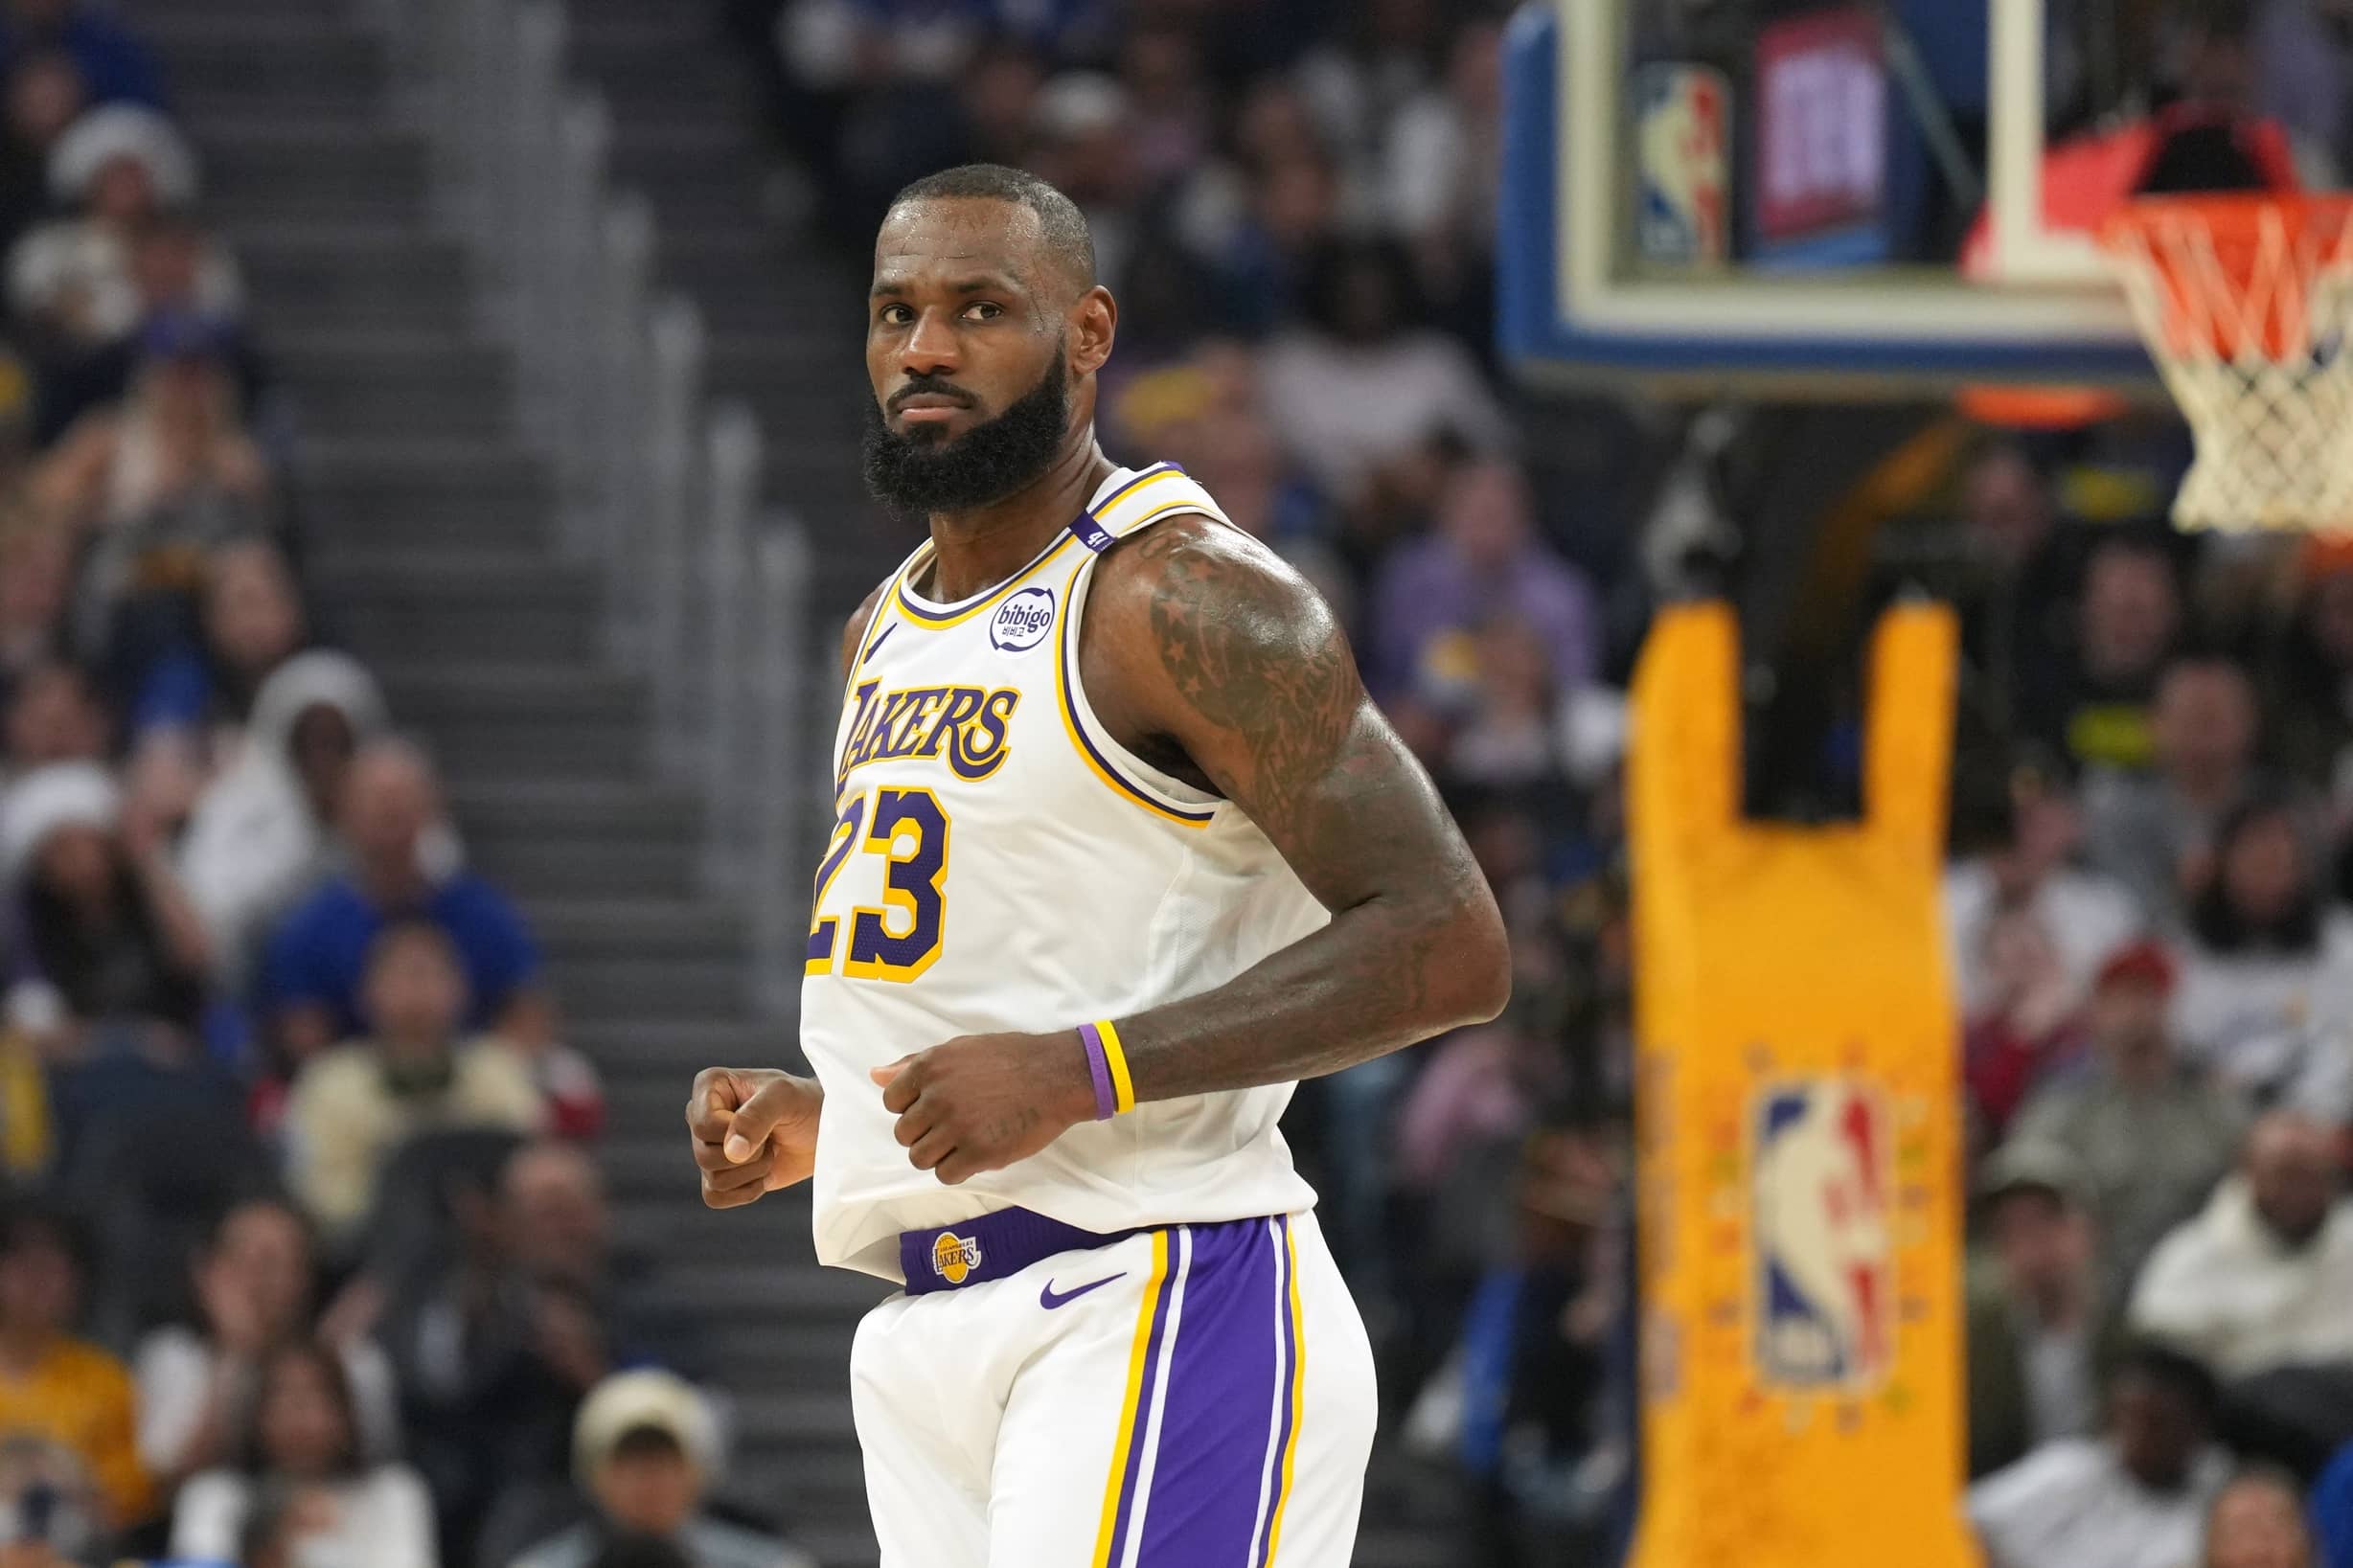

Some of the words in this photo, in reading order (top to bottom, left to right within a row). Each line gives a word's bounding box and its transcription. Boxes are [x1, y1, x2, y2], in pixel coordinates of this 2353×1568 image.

[997, 604, 1050, 633] bibigo
[836, 675, 1022, 808] LAKERS
[805, 784, 951, 984] 23
[934, 1246, 979, 1273] LAKERS
